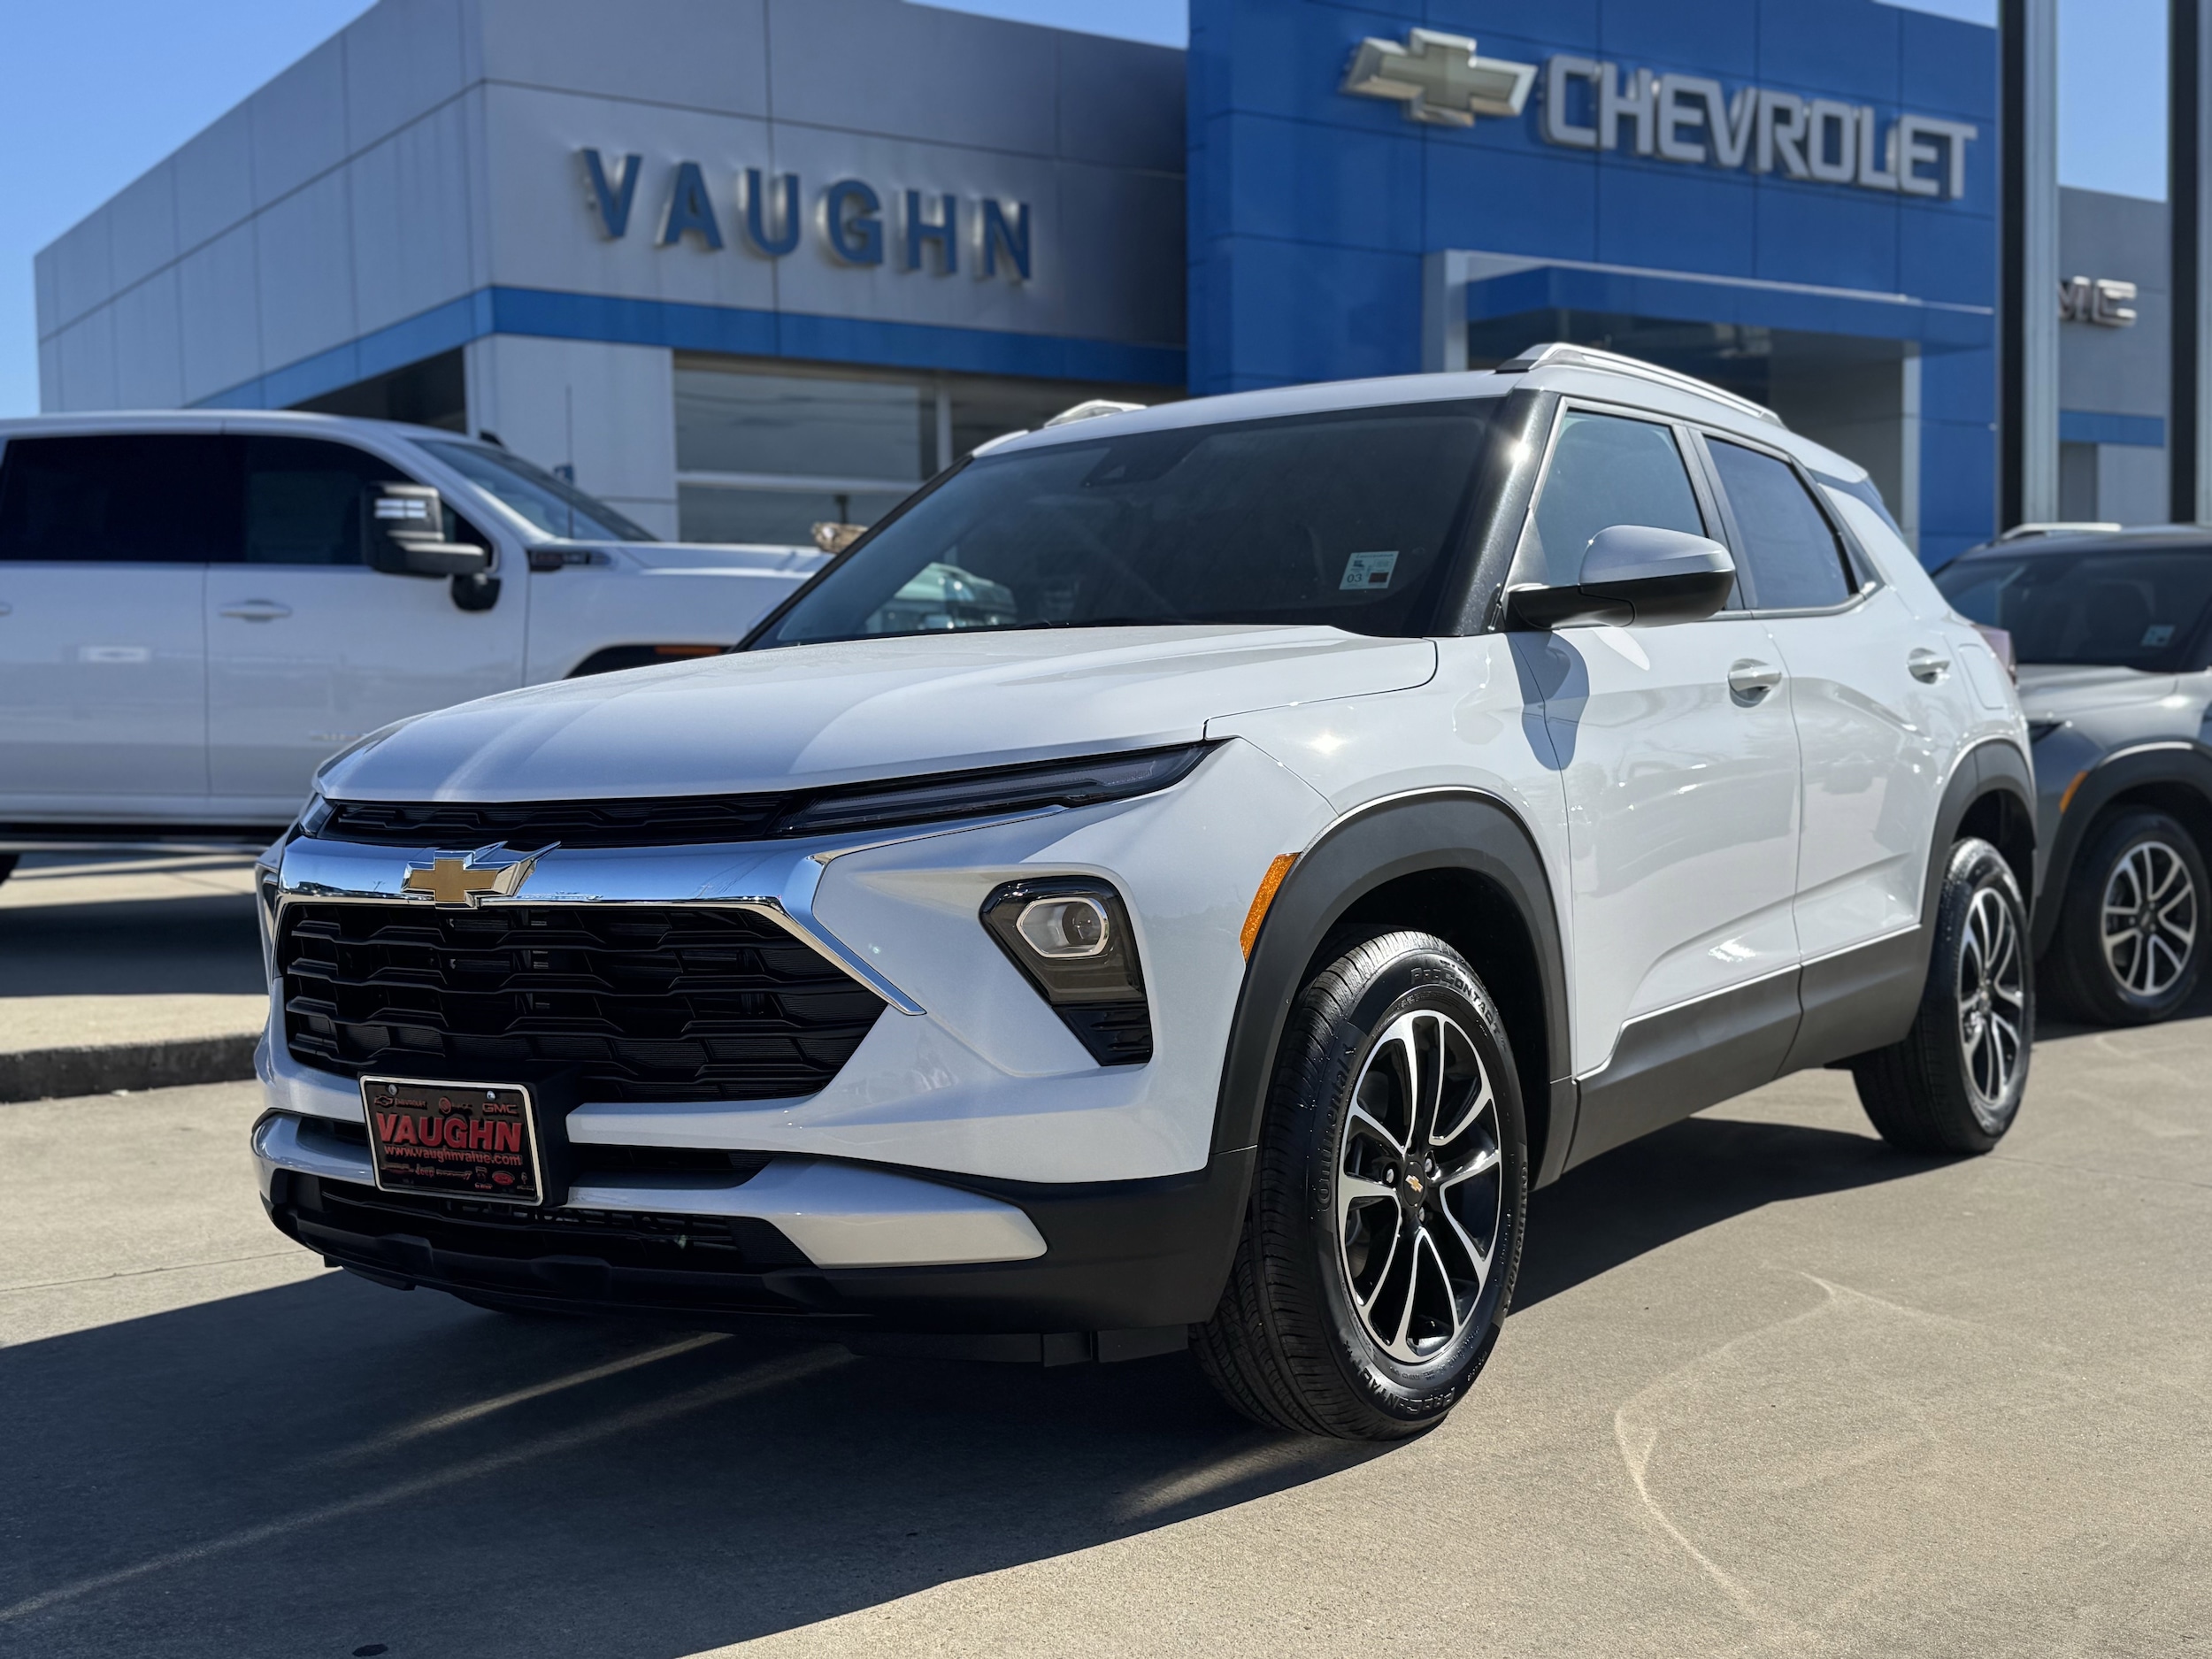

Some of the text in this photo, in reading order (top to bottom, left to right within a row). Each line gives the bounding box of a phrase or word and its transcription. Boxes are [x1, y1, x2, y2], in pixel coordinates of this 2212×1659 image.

[1545, 54, 1978, 200] CHEVROLET
[580, 143, 1032, 282] VAUGHN
[2058, 275, 2138, 326] MC
[1347, 573, 1363, 583] 03
[482, 1102, 519, 1115] GMC
[375, 1112, 523, 1153] VAUGHN
[384, 1145, 522, 1165] www.vaughnvalue.com
